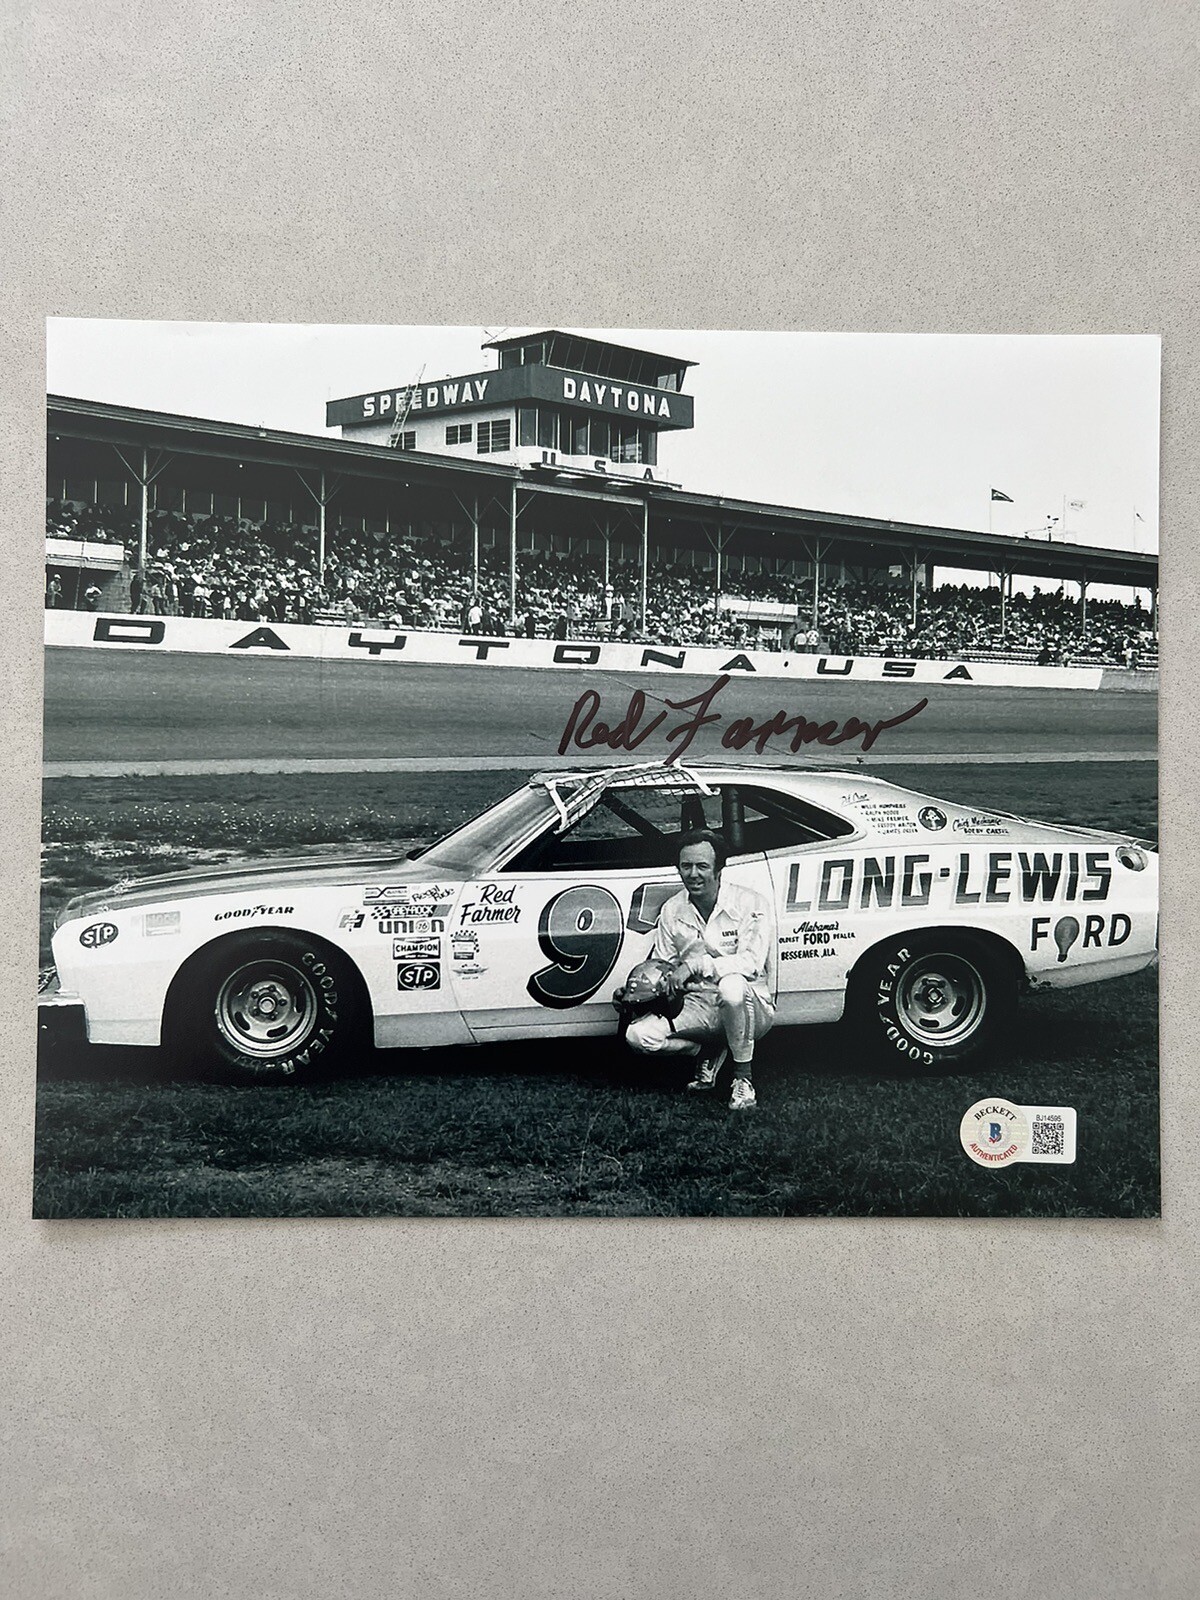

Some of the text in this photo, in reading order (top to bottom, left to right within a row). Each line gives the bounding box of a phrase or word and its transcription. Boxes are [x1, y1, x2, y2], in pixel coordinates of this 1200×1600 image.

[363, 379, 488, 417] SPEEDWAY
[563, 377, 671, 418] DAYTONA
[93, 617, 973, 681] DAYTONA USA
[558, 674, 929, 766] Red Farmer
[214, 904, 295, 922] GOODYEAR
[460, 903, 522, 926] Farmer
[82, 922, 116, 946] STP
[778, 932, 856, 945] OLDEST FORD DEALER
[395, 944, 438, 953] CHAMPION
[402, 965, 435, 986] STP
[973, 1106, 1017, 1121] BECKETT
[969, 1142, 1018, 1162] AUTHENTICATED
